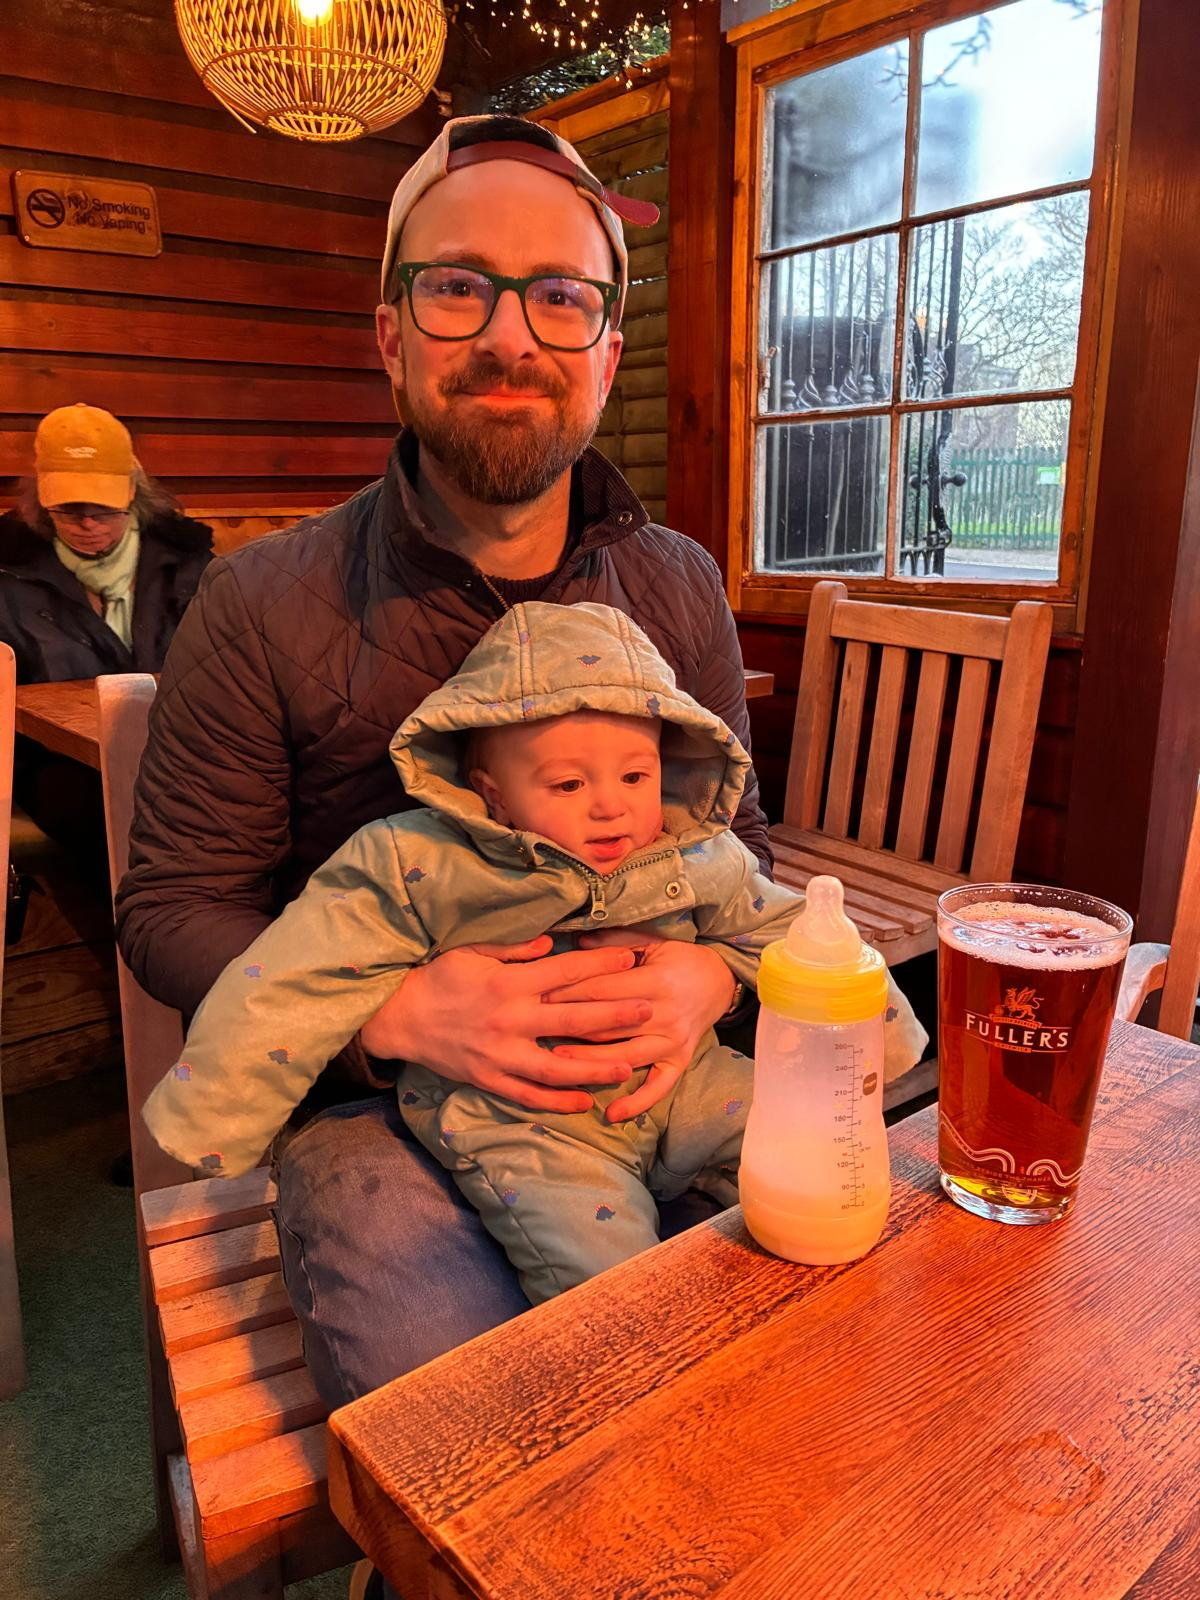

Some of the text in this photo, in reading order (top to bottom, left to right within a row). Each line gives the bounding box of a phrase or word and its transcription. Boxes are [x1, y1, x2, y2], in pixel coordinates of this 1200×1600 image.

[66, 194, 150, 221] No Smoking
[75, 211, 146, 235] No Vaping
[965, 1013, 1069, 1049] FULLER'S
[833, 1136, 846, 1144] 150
